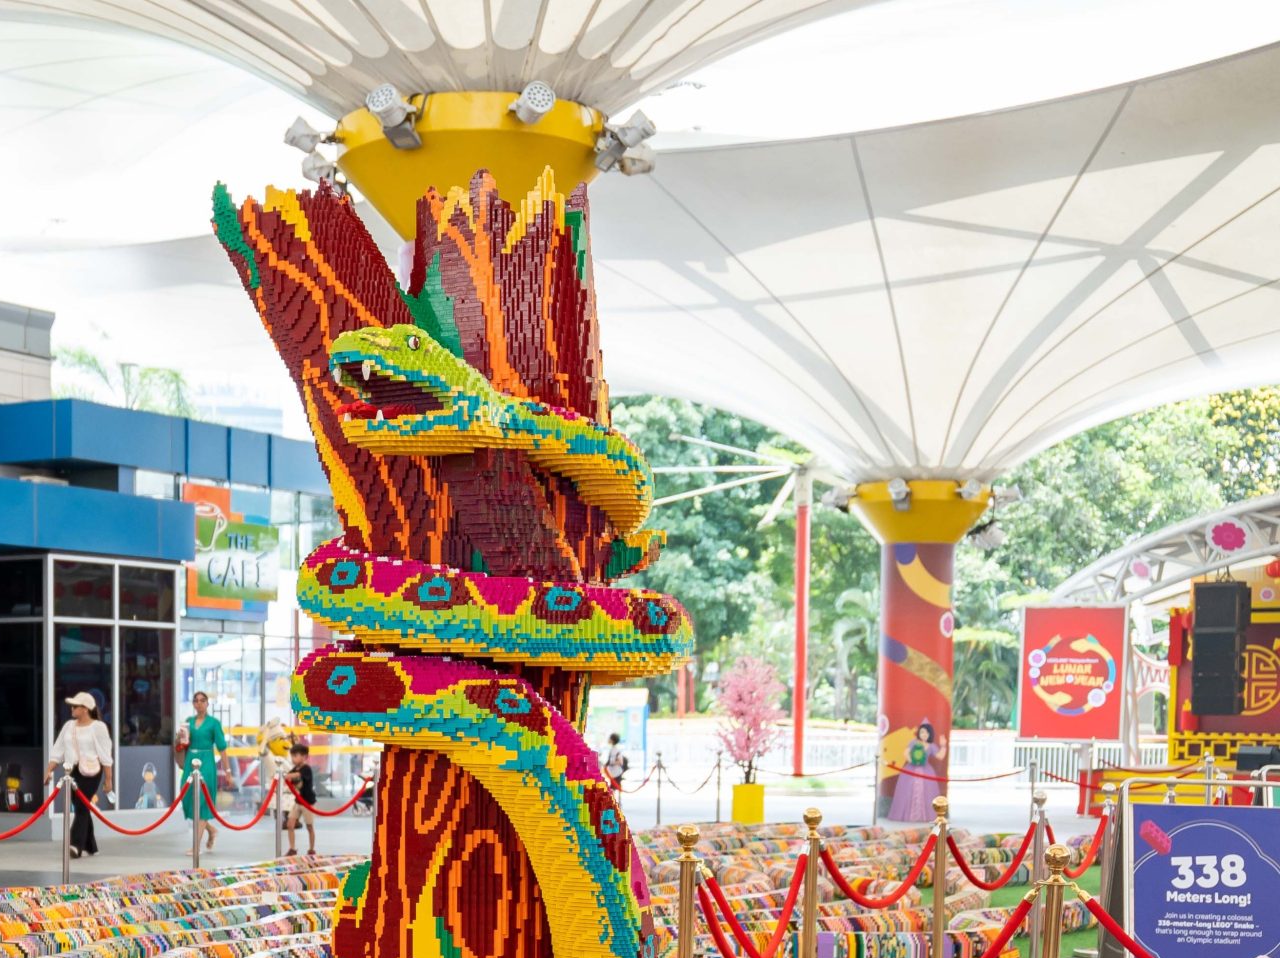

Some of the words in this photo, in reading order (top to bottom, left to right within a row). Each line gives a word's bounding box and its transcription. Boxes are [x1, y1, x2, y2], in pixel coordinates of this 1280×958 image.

[226, 533, 253, 551] THE
[1053, 663, 1092, 674] LUNAR
[1040, 675, 1066, 687] NEW
[1073, 674, 1104, 687] YEAR
[1170, 854, 1247, 889] 338
[1166, 890, 1213, 904] Meters
[1214, 892, 1251, 907] Long!
[1195, 913, 1221, 922] creating
[1157, 919, 1212, 929] 338-meter-long
[1234, 922, 1255, 930] Snake
[1173, 928, 1188, 937] long
[1189, 929, 1214, 937] enough
[1186, 936, 1213, 945] Olympic
[1214, 937, 1241, 945] stadium!
